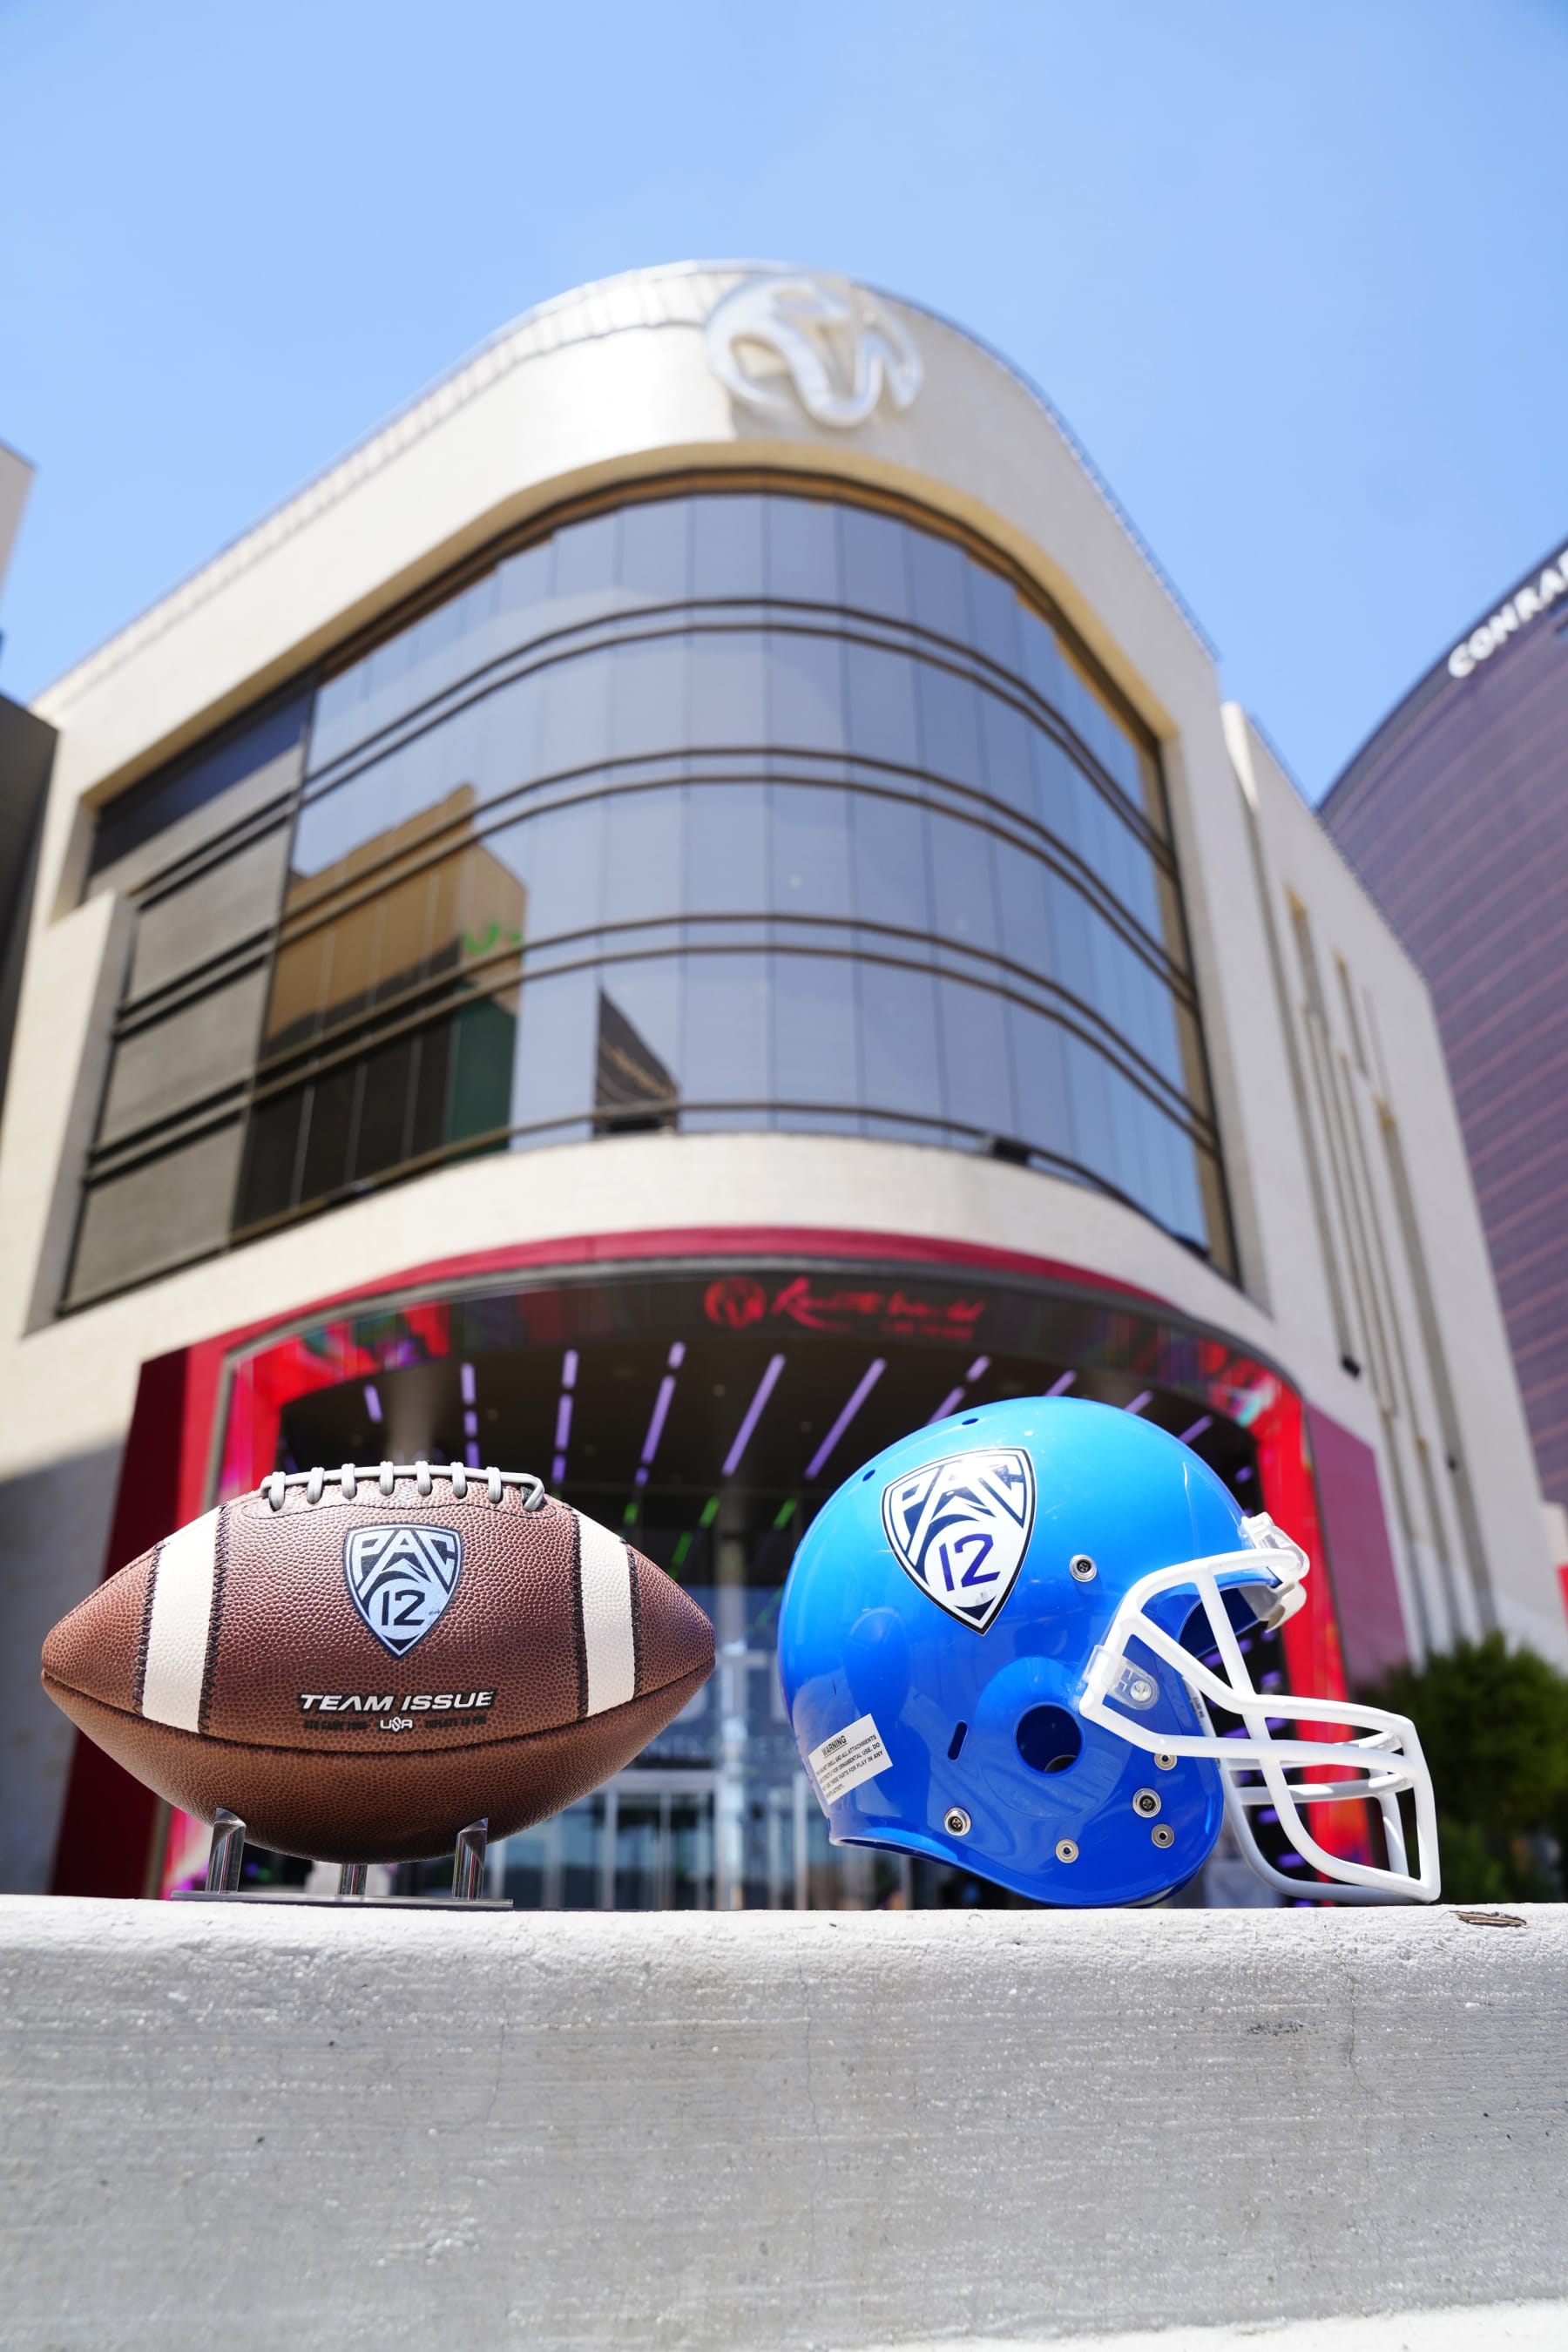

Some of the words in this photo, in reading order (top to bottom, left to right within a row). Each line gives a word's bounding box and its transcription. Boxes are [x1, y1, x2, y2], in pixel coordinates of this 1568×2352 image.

[889, 1455, 1025, 1568] PAC
[350, 1530, 456, 1598] PAC
[938, 1533, 1001, 1592] 12
[381, 1590, 426, 1626] 12
[301, 1693, 395, 1712] TEAM
[401, 1691, 493, 1711] ISSUE
[380, 1716, 414, 1733] USA
[821, 1735, 848, 1757] WARNING
[872, 1741, 881, 1750] DO
[873, 1749, 884, 1759] ANY
